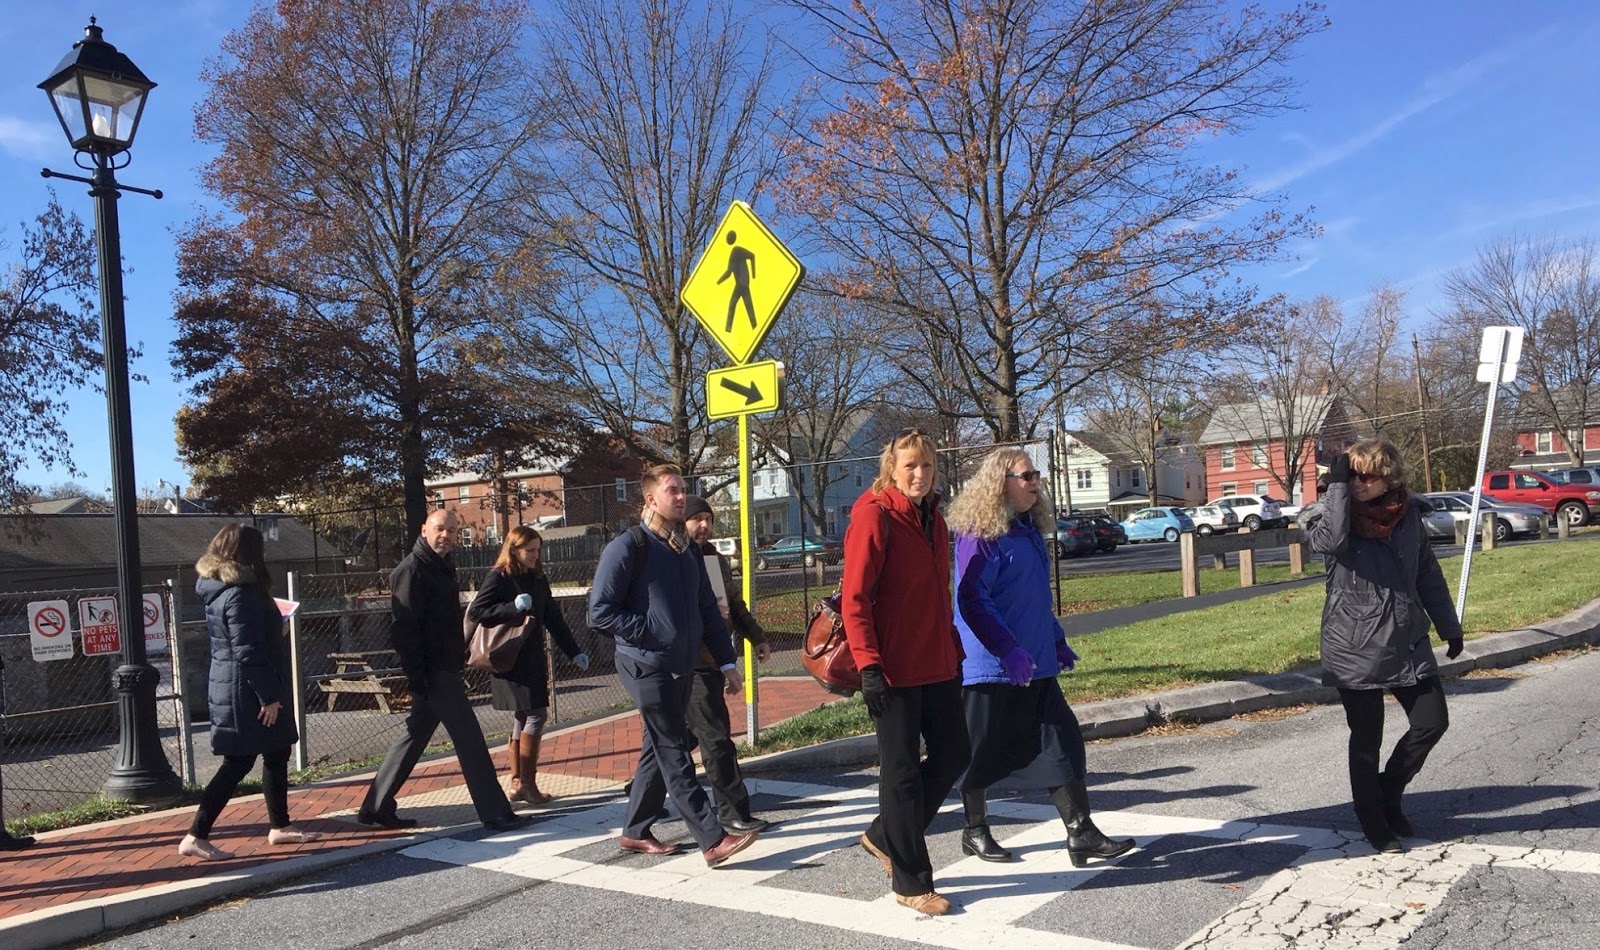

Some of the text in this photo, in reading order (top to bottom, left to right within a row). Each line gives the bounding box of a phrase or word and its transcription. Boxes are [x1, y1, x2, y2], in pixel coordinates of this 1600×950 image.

[83, 625, 117, 636] NO PETS
[87, 634, 116, 645] AT ANY
[144, 632, 165, 640] BIKES
[92, 643, 113, 652] TIME
